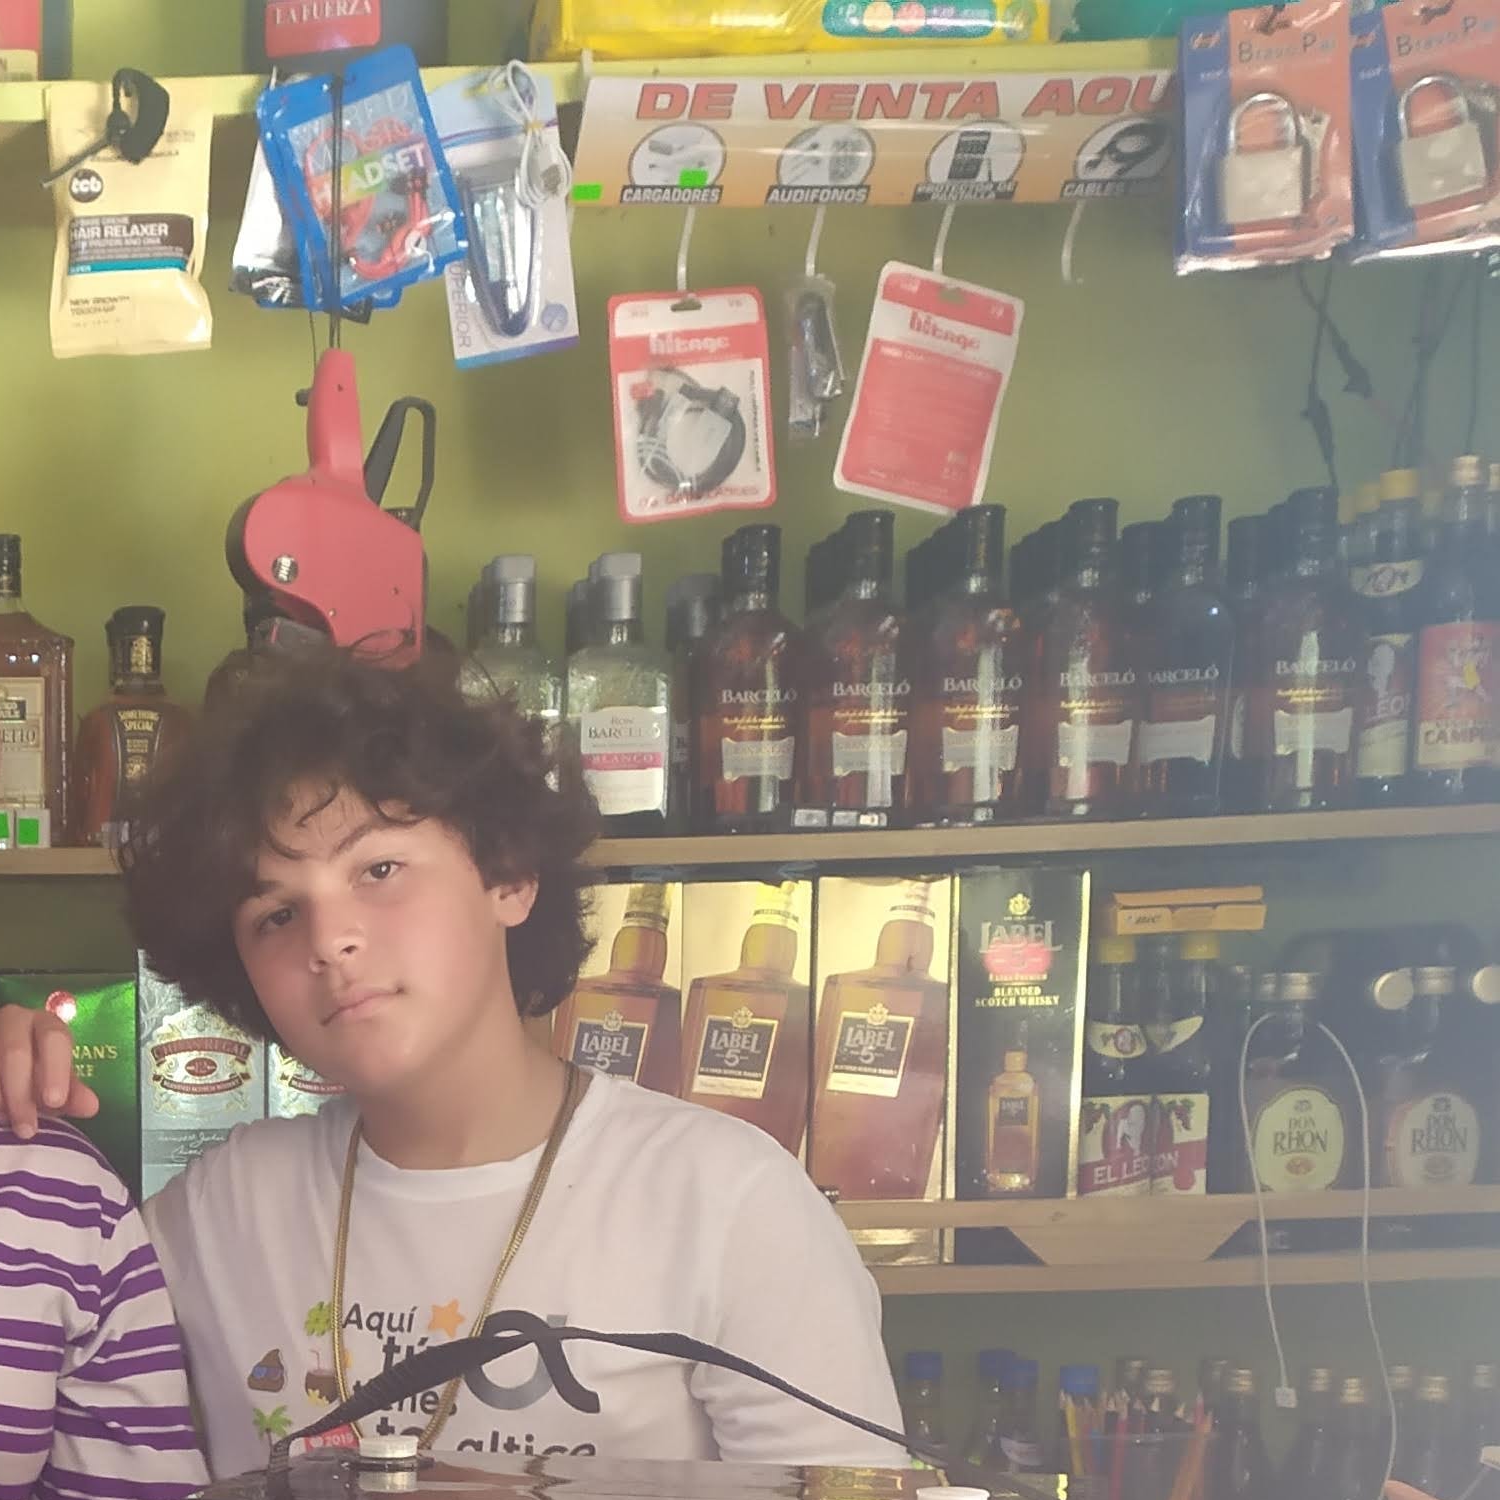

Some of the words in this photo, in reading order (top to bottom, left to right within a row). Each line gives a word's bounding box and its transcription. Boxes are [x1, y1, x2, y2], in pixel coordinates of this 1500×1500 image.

[636, 83, 738, 120] DE
[764, 81, 1000, 120] VENTA
[622, 187, 720, 202] CARGADORES
[768, 188, 867, 201] AUDIFONOS
[104, 222, 169, 239] RELAXER
[722, 688, 797, 704] BARCELÓ
[833, 680, 911, 698] BARCELÓ
[994, 986, 1041, 997] BLENDED
[1018, 995, 1060, 1006] WHISKY
[580, 1031, 633, 1057] LABEL
[709, 1028, 762, 1054] LABEL
[844, 1026, 897, 1052] LABEL
[595, 1050, 612, 1071] 5
[723, 1048, 740, 1067] 5
[860, 1045, 876, 1064] 5
[1273, 1129, 1328, 1155] RHON
[1411, 1127, 1468, 1156] RHON
[342, 1303, 418, 1340] Aquí
